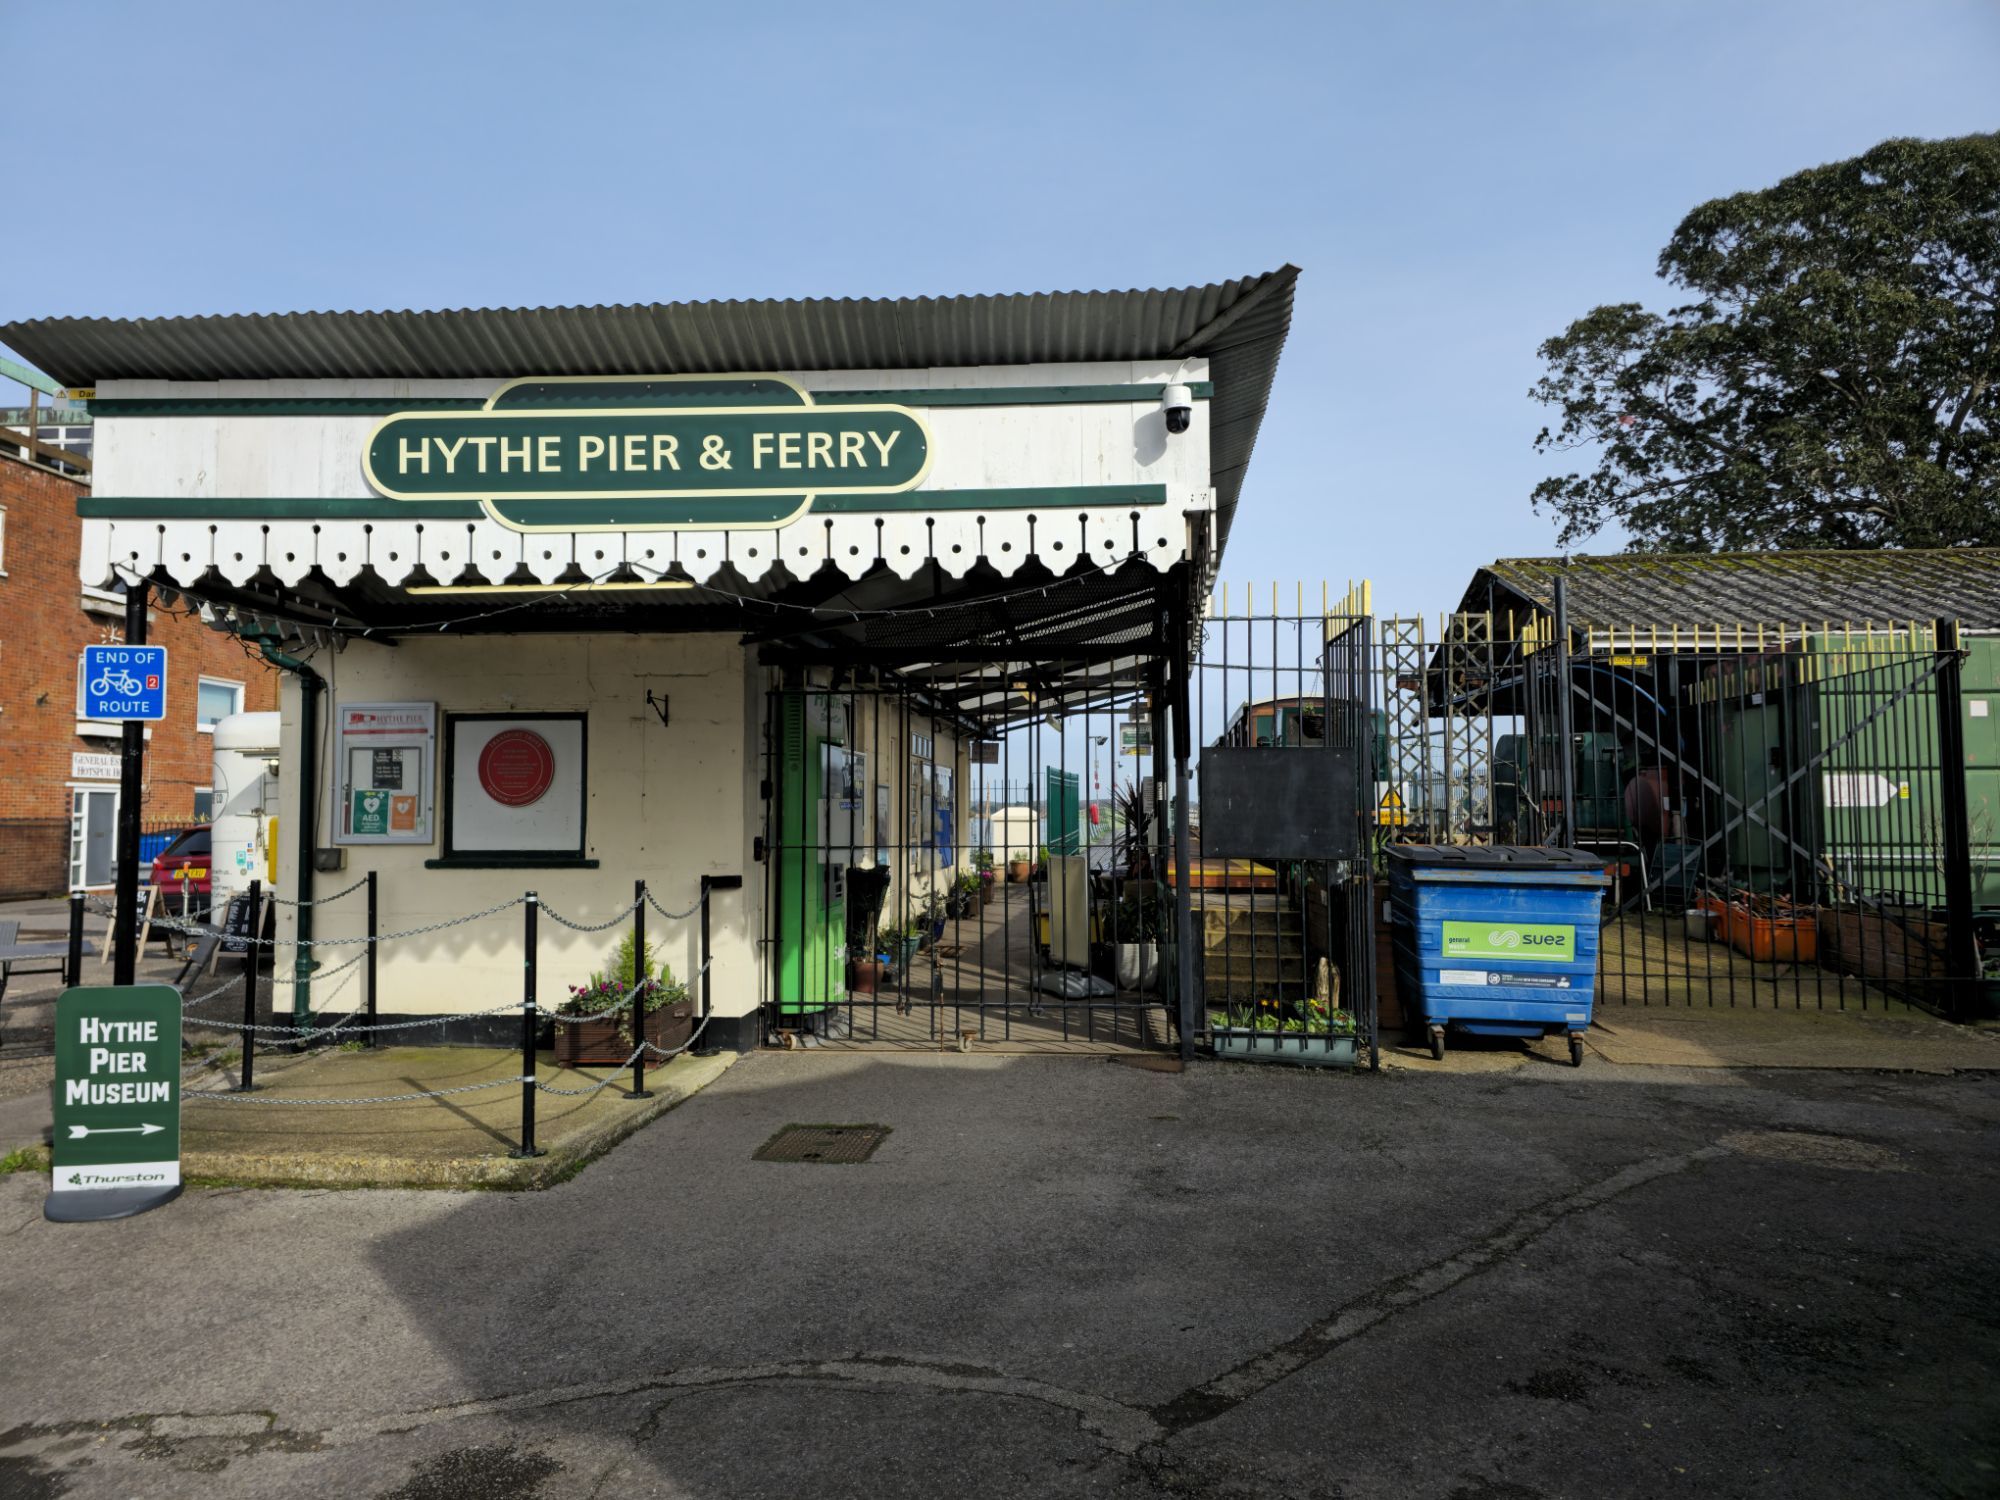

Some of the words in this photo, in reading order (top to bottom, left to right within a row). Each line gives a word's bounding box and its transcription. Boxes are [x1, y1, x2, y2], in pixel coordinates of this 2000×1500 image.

[399, 436, 562, 474] HYTHE
[579, 434, 681, 472] PIER
[699, 434, 733, 470] &
[752, 430, 901, 469] FERRY
[96, 651, 128, 664] END
[135, 652, 156, 664] OF
[148, 677, 157, 688] 2
[99, 701, 150, 713] ROUTE
[377, 714, 404, 723] HYTHE
[74, 755, 107, 766] GENERAL
[77, 766, 111, 776] HOTSPUR
[362, 814, 380, 822] AED
[1522, 934, 1565, 946] suez
[80, 1017, 158, 1044] HYTHE
[90, 1047, 147, 1073] PIER
[65, 1079, 170, 1106] MUSEUM
[83, 1172, 165, 1185] Thurston
